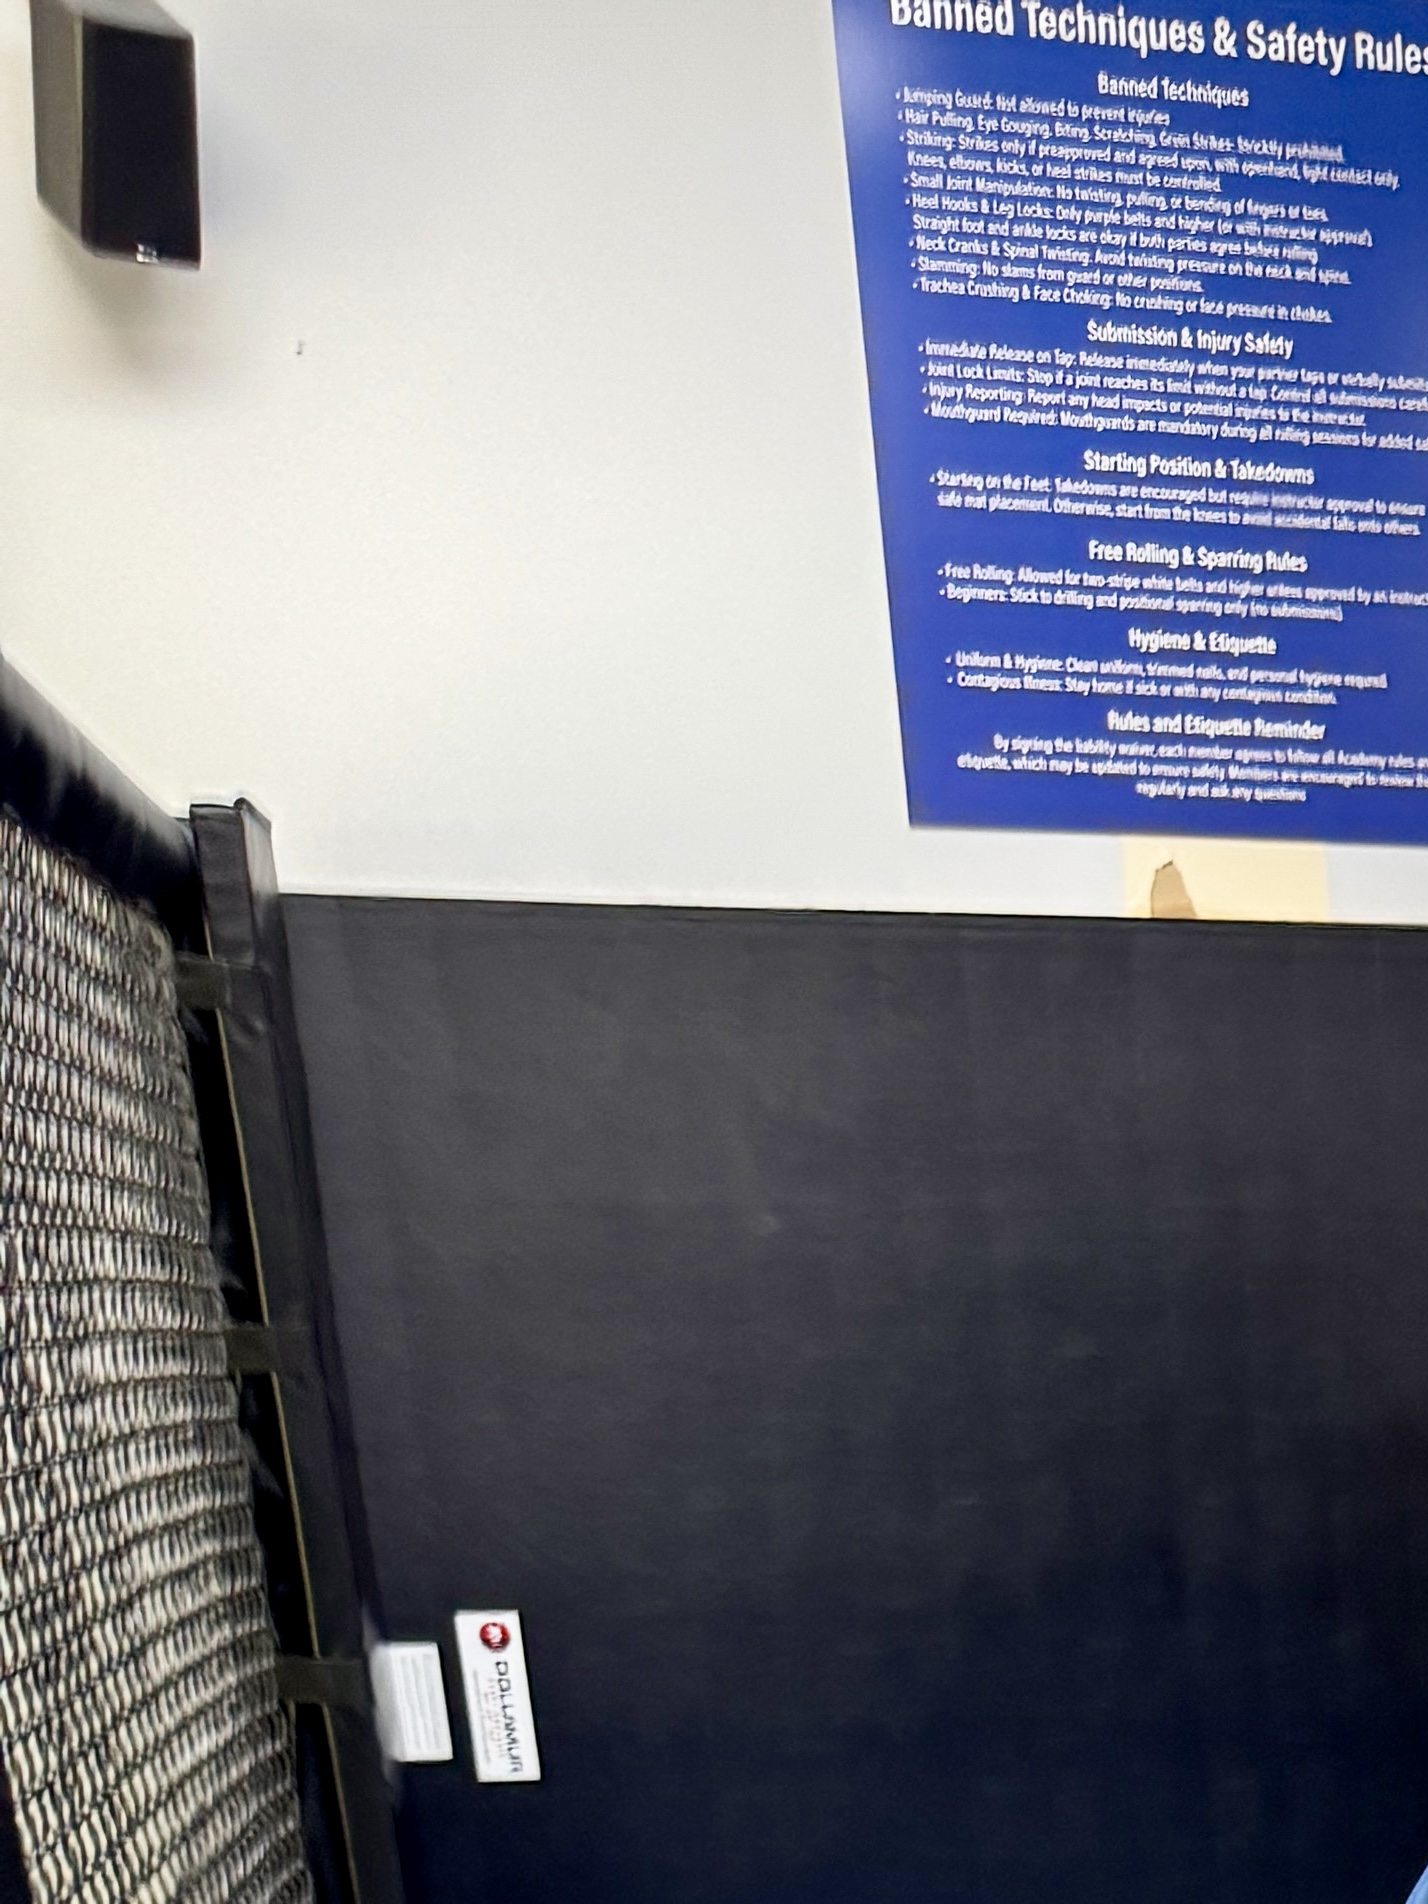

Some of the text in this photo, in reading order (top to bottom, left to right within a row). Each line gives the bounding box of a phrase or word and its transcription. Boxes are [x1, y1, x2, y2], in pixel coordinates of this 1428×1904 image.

[890, 0, 1014, 36] Banned
[1020, 0, 1205, 59] Techniques
[1213, 16, 1238, 58] &
[1247, 19, 1347, 77] Safety
[1097, 74, 1249, 108] Banned Techniques
[1087, 321, 1293, 360] Submission & Injury Safety
[1084, 450, 1314, 485] Starting Position & Takedowns
[1089, 540, 1307, 573] Free Rolling & Sparring Rules
[1127, 627, 1276, 656] Hygiene & Etiquette
[1107, 711, 1325, 741] Rules and Etiquette Reminder
